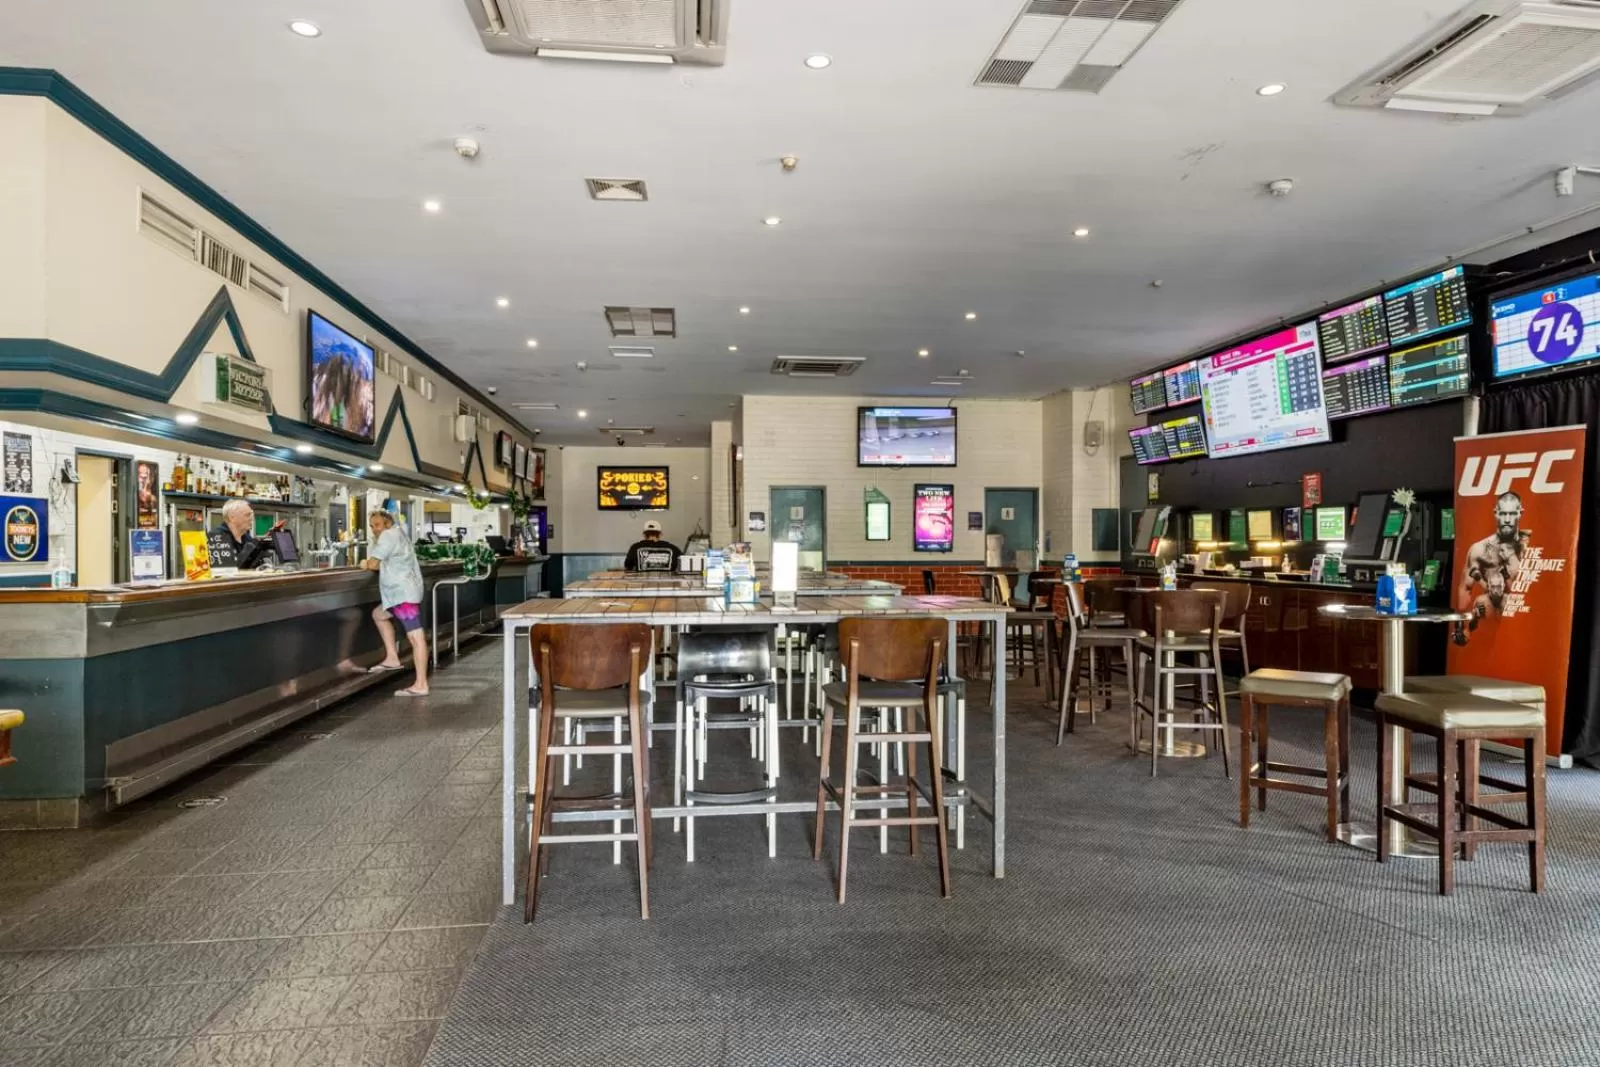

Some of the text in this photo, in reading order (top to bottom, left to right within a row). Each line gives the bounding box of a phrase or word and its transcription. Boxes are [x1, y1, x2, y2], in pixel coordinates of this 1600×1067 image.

[1532, 312, 1578, 352] 74
[614, 472, 652, 482] POKIES
[1458, 449, 1576, 496] UFC
[13, 535, 31, 545] NEW
[1524, 547, 1544, 559] THE
[1519, 558, 1566, 572] ULTIMATE
[1516, 570, 1542, 582] TIME
[1511, 581, 1532, 593] OUT
